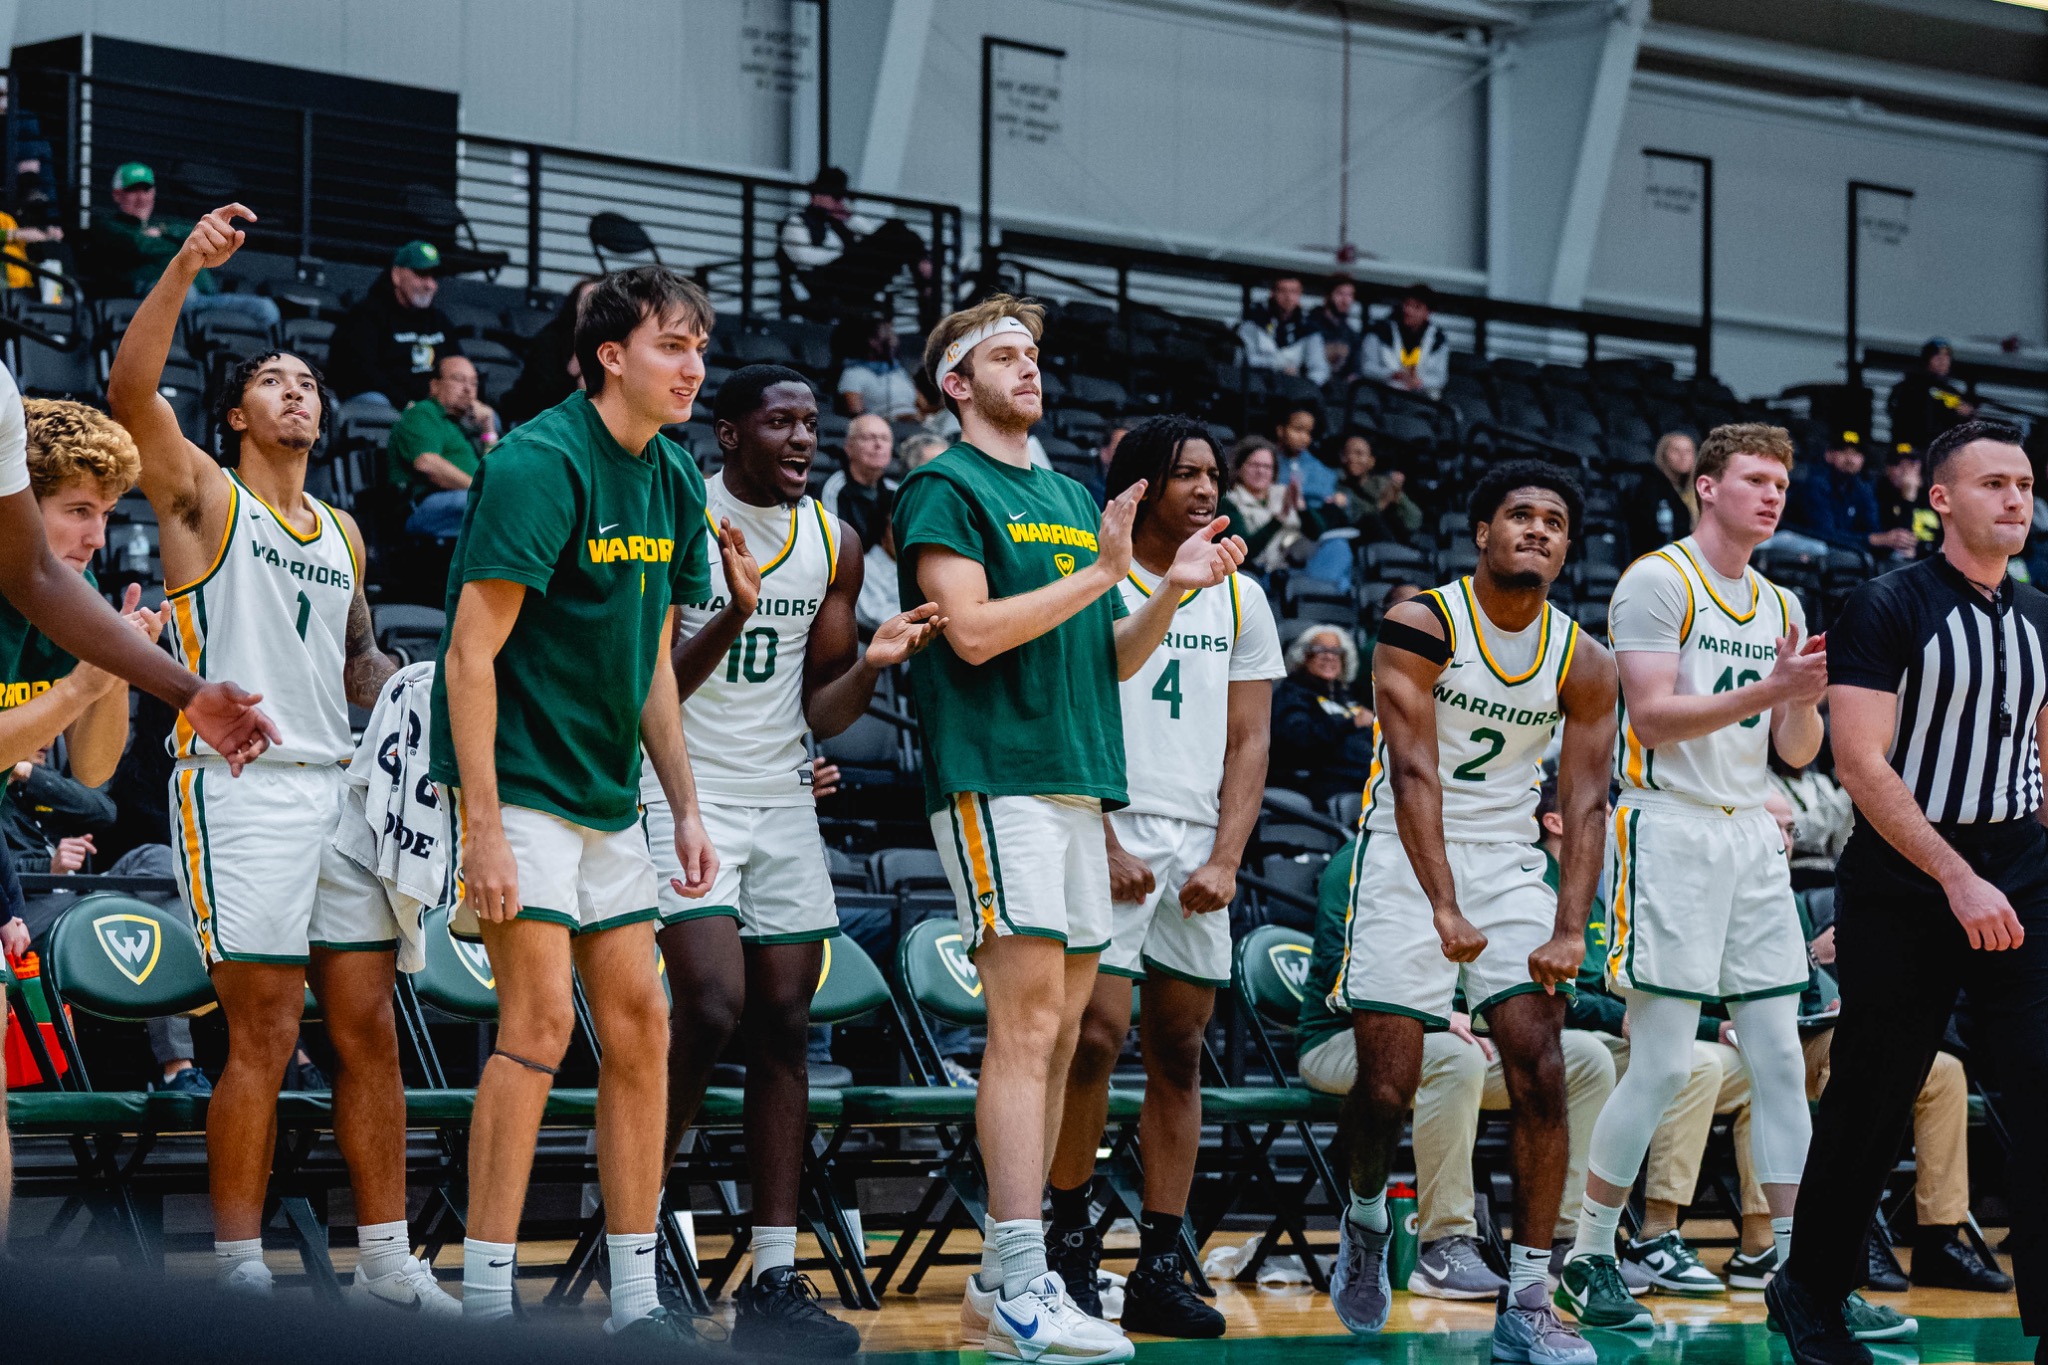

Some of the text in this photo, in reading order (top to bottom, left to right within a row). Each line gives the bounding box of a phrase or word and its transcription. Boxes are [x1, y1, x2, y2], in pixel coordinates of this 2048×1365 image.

[1006, 522, 1098, 553] WARRIORS
[251, 539, 350, 591] WARIORS
[296, 589, 311, 643] 1
[688, 594, 818, 617] WARIORS
[726, 626, 779, 683] 10
[1160, 631, 1229, 653] RIORS
[1151, 658, 1183, 720] 4
[1432, 684, 1559, 726] WARRIORS
[1452, 726, 1507, 782] 2
